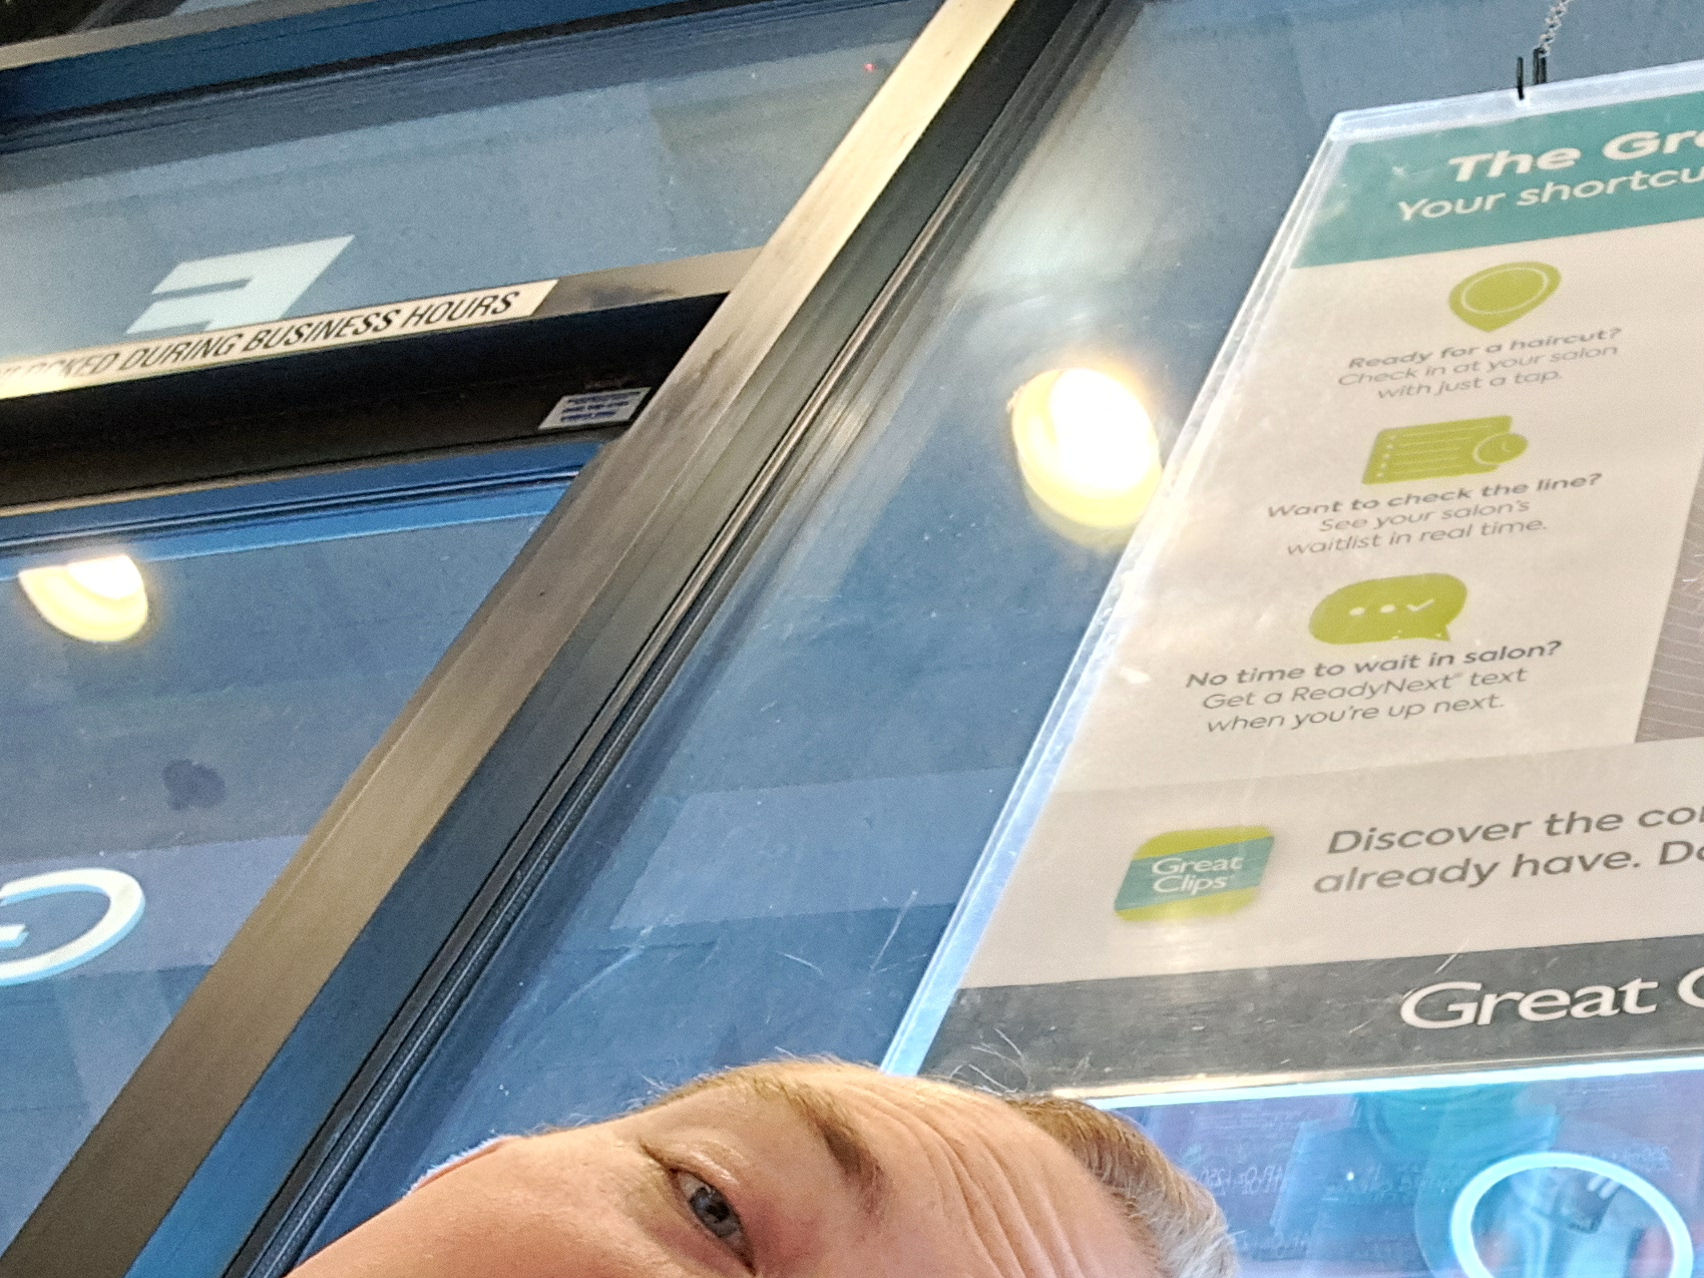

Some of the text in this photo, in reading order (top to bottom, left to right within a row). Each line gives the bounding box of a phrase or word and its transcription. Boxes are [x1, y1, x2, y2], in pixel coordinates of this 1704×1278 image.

[1449, 145, 1582, 183] The
[1398, 192, 1506, 222] Your
[119, 332, 244, 371] DURING
[241, 308, 402, 352] BUSINESS
[401, 291, 520, 328] HOURS
[1349, 327, 1622, 369] Ready for a haircut?
[1338, 346, 1618, 386] Check in at your salon
[1377, 370, 1563, 399] with just a tap.
[1267, 473, 1602, 518] Want to check the line?
[1319, 500, 1531, 532] See your salon's
[1286, 517, 1548, 556] waitlist in real time.
[1185, 640, 1562, 688] No time to wait in salon?
[1201, 691, 1257, 711] Get
[1263, 690, 1283, 704] a
[1469, 667, 1529, 686] text
[1206, 694, 1505, 733] when you're up next.
[1327, 817, 1533, 855] Discover
[1545, 810, 1625, 837] the
[1151, 856, 1245, 875] Great
[1313, 856, 1500, 894] already
[1511, 849, 1641, 878] have.
[1400, 977, 1660, 1030] Great
